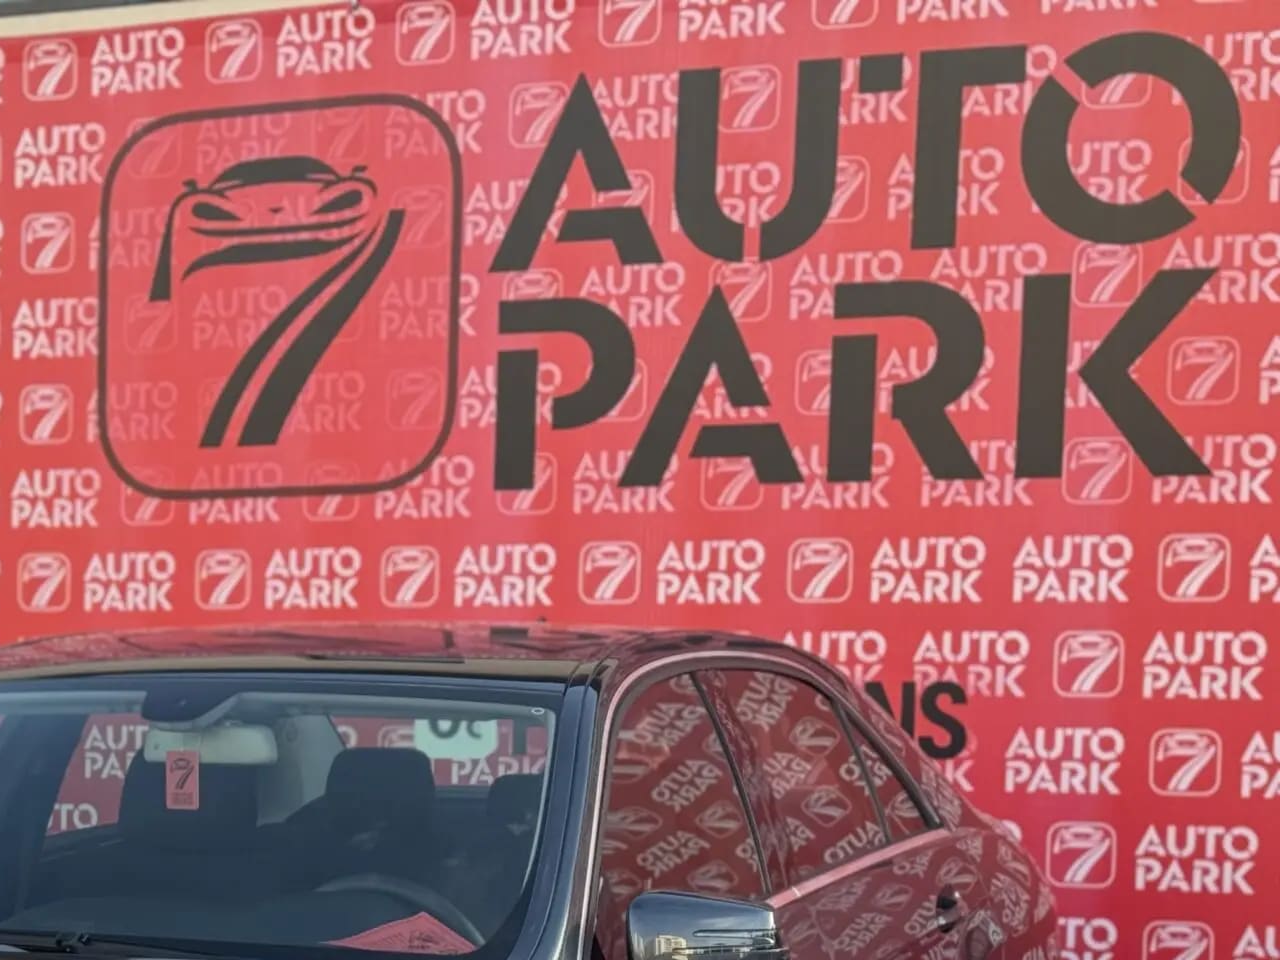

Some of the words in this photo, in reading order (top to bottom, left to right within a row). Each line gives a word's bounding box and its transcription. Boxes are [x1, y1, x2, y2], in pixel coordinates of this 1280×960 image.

[276, 8, 375, 47] AUTO
[471, 0, 575, 27] AUTO
[679, 3, 785, 43] PARK
[91, 28, 184, 64] AUTO
[470, 21, 572, 61] PARK
[277, 40, 373, 78] PARK
[91, 59, 183, 97] PARK
[14, 124, 105, 158] AUTO
[489, 30, 1243, 272] AUTO
[15, 155, 104, 188] PARK
[789, 249, 903, 287] AUTO
[931, 243, 1048, 279] AUTO
[1163, 233, 1280, 270] AUTO
[580, 262, 686, 296] AUTO
[13, 299, 99, 329] AUTO
[13, 326, 99, 359] PARK
[495, 262, 1215, 490] PARK
[12, 469, 102, 499] AUTO
[573, 483, 676, 514] PARK
[921, 476, 1035, 508] PARK
[1151, 469, 1272, 504] PARK
[12, 497, 99, 528] PARK
[375, 486, 471, 520] PARK
[84, 551, 177, 583] AUTO
[265, 547, 362, 579] AUTO
[454, 543, 557, 576] AUTO
[658, 539, 765, 572] AUTO
[871, 536, 986, 570] AUTO
[1013, 535, 1134, 570] AUTO
[84, 578, 173, 613] PARK
[265, 575, 358, 611] PARK
[454, 571, 553, 608] PARK
[658, 569, 763, 605] PARK
[871, 570, 982, 603] PARK
[1013, 569, 1129, 603] PARK
[914, 630, 1029, 664] AUTO
[1143, 631, 1267, 666] AUTO
[914, 664, 1026, 697] PARK
[1142, 664, 1264, 699] PARK
[1005, 727, 1125, 760] AUTO
[1005, 760, 1122, 794] PARK
[1134, 825, 1259, 860] AUTO
[1135, 859, 1254, 895] PARK
